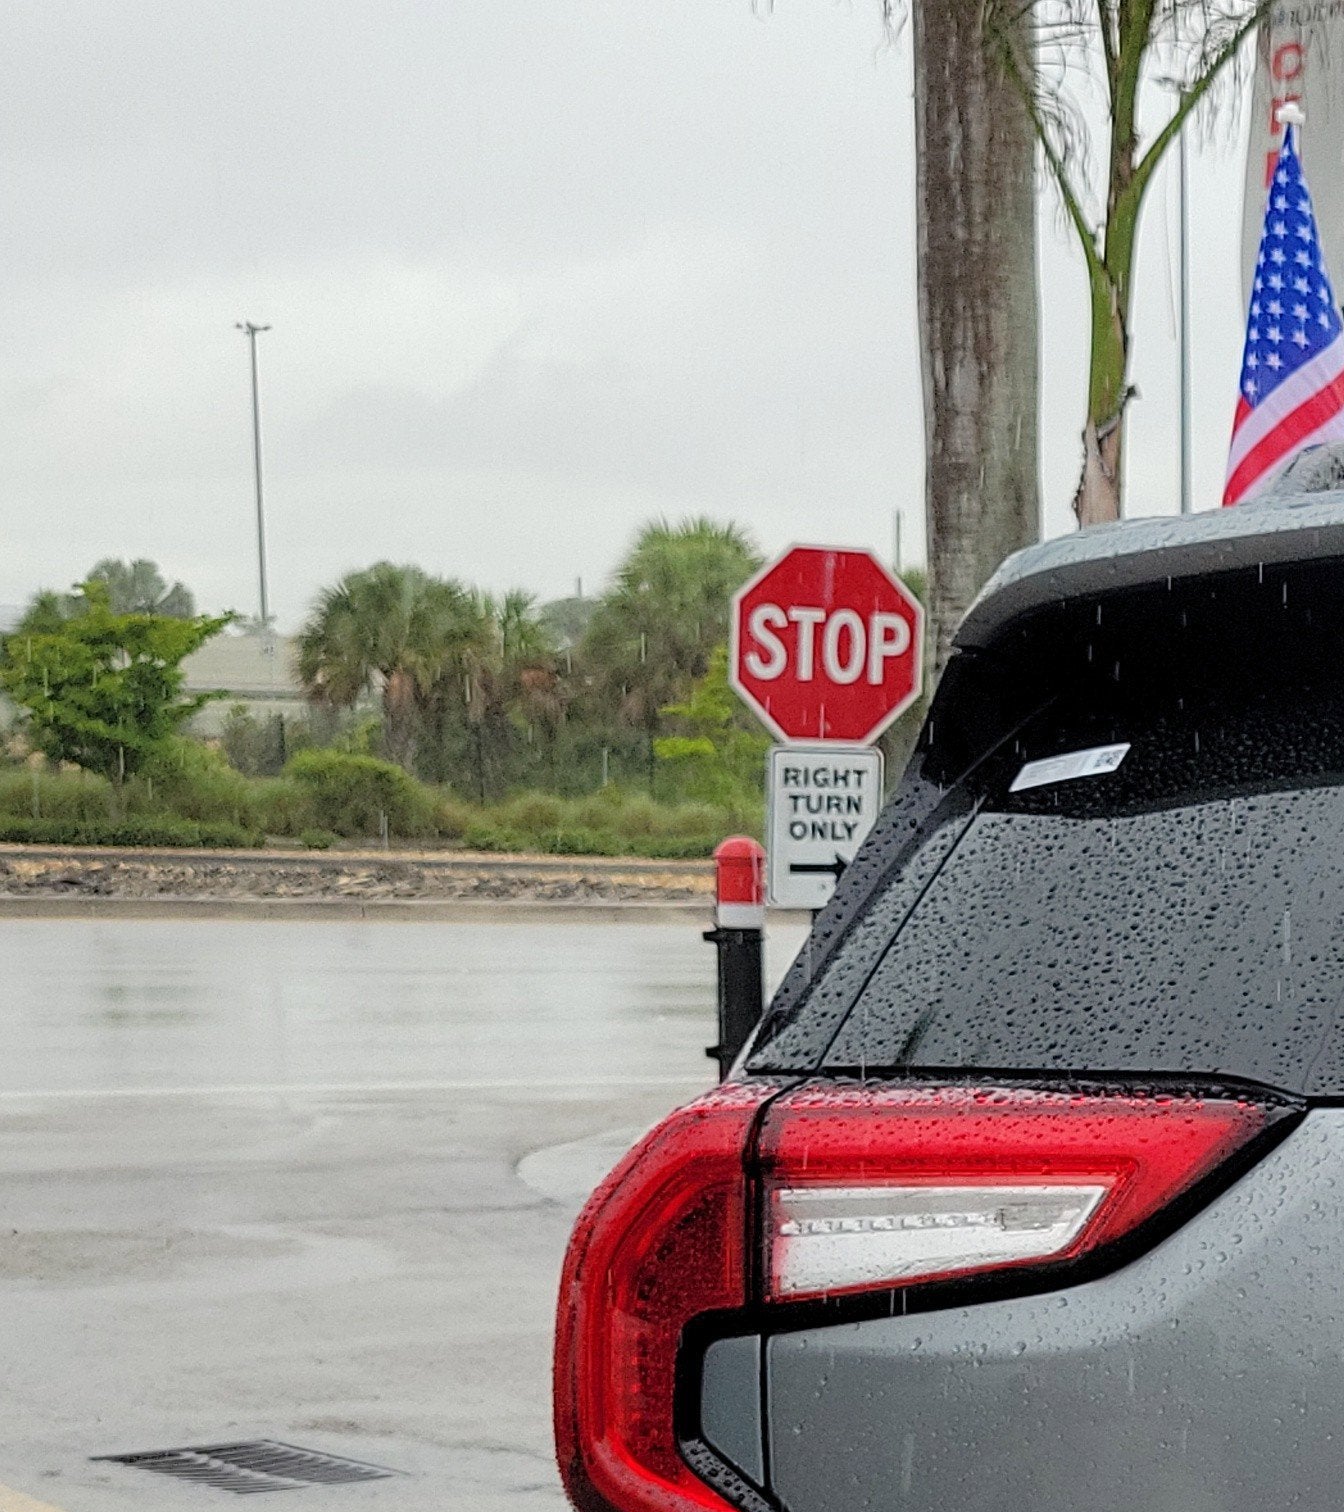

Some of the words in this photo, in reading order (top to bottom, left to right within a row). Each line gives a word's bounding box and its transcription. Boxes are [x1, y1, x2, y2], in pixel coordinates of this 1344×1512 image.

[744, 602, 912, 686] STOP
[783, 766, 869, 790] RIGHT
[788, 794, 862, 816] TURN
[788, 820, 860, 842] ONLY
